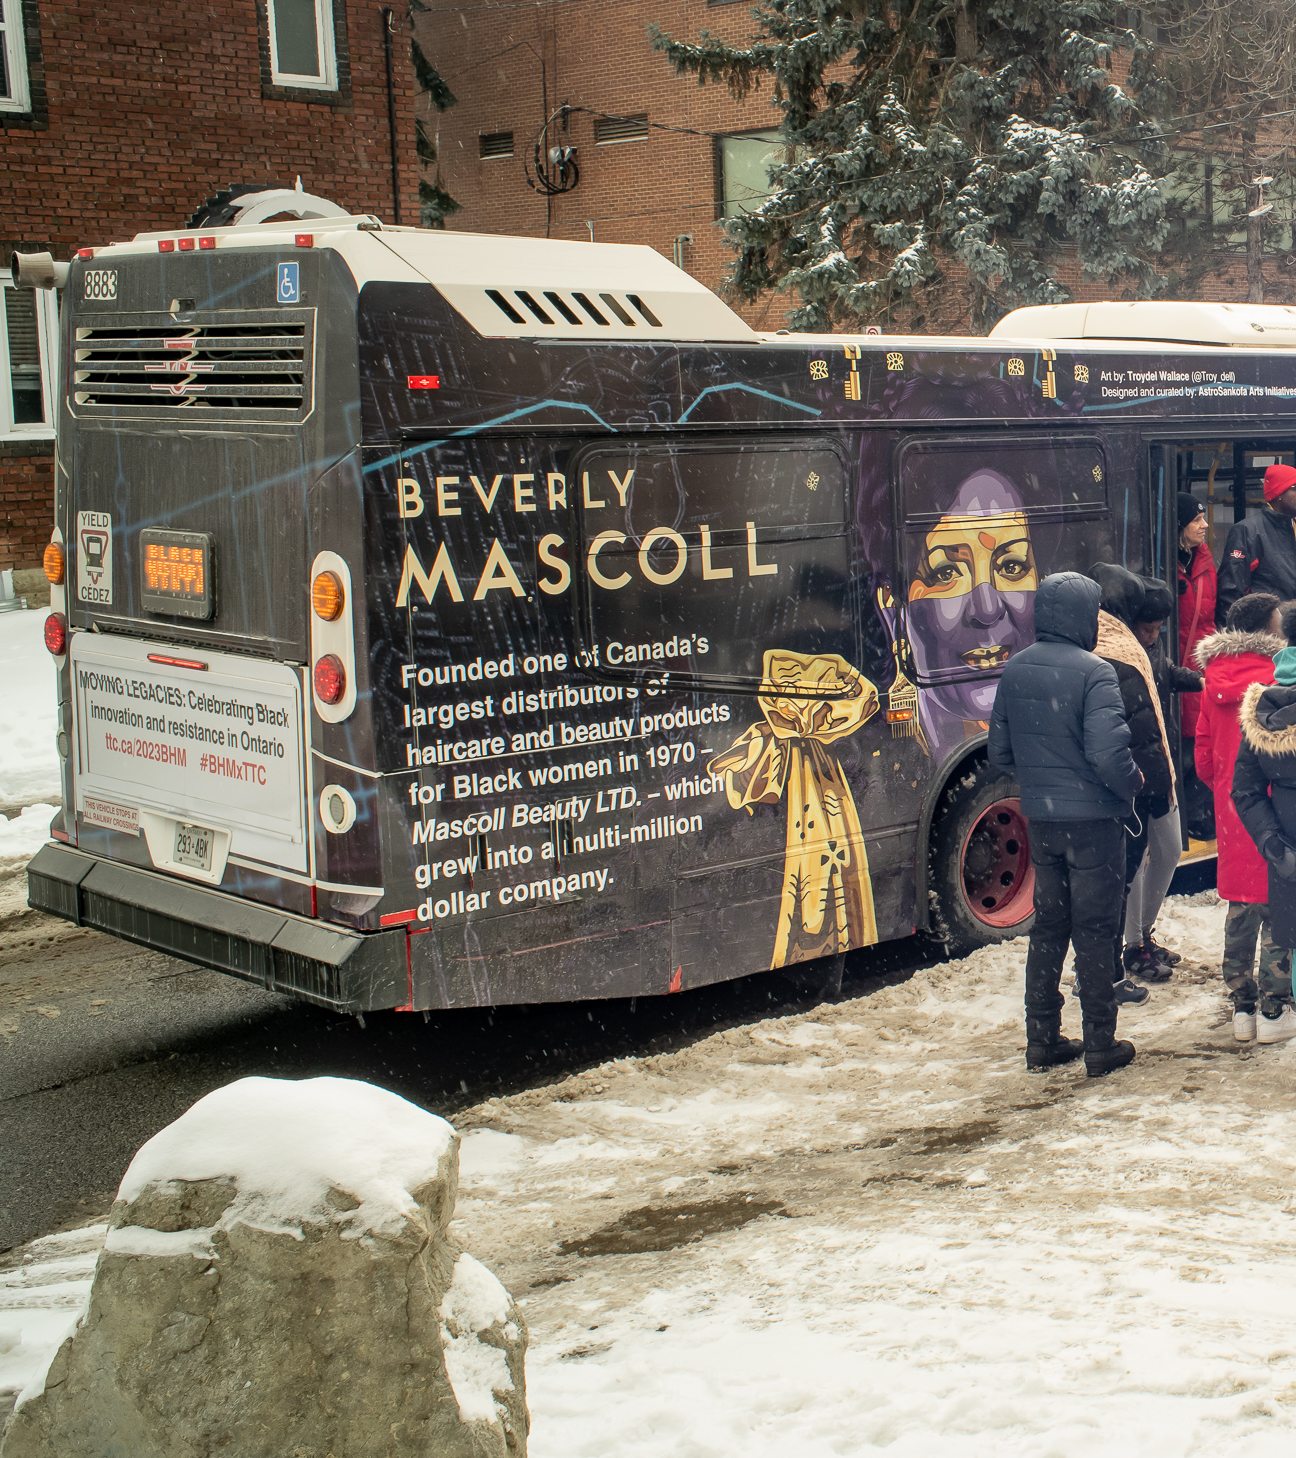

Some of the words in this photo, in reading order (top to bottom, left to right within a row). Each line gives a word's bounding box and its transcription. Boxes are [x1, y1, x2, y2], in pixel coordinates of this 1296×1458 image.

[85, 271, 117, 298] 8883
[1100, 371, 1113, 382] Art
[1113, 371, 1126, 383] by:
[1127, 371, 1158, 383] Troydel
[1158, 371, 1190, 382] Wallace
[1191, 371, 1236, 384] (@Troy_dell)
[1101, 386, 1139, 399] Designed
[1140, 387, 1154, 397] and
[1156, 387, 1184, 397] curated
[1185, 386, 1197, 398] by:
[1198, 386, 1248, 396] AstroSankofa
[1248, 386, 1264, 396] Arts
[396, 470, 636, 518] BEVERLY
[80, 512, 109, 528] YIELD
[149, 544, 203, 564] BLACK
[395, 521, 779, 608] MASCOLL
[81, 584, 110, 603] CÉDEZ
[401, 653, 515, 689] Founded
[523, 652, 568, 675] one
[79, 670, 125, 696] MOVING
[126, 678, 187, 708] LEGACIES:
[188, 690, 254, 726] Celebrating
[255, 702, 290, 729] Black
[403, 695, 495, 730] largest
[502, 683, 640, 715] distributors
[646, 672, 670, 697] of
[90, 700, 144, 729] innovation
[146, 714, 166, 734] and
[168, 718, 225, 746] resistance
[226, 728, 238, 749] in
[240, 730, 285, 759] Ontario
[406, 736, 506, 767] haircare
[511, 724, 555, 752] and
[560, 718, 635, 743] beauty
[640, 702, 731, 738] products
[105, 732, 187, 768] ttc.ca/2023BHM
[200, 752, 267, 786] #BHMxTTC
[408, 780, 446, 806] for
[453, 767, 523, 799] Black
[528, 758, 612, 787] women
[618, 750, 640, 774] in
[646, 741, 696, 769] 1970
[84, 811, 92, 820] ALL
[92, 812, 113, 825] RAILWAY
[112, 818, 140, 832] CROSSINGS
[85, 800, 96, 810] THIS
[96, 802, 116, 815] VEHICLE
[116, 808, 131, 819] STOPS
[132, 812, 138, 820] AT
[412, 807, 505, 845] Mascoll
[511, 796, 592, 829] Beauty
[595, 787, 642, 814] LTD.
[664, 772, 725, 802] which
[414, 855, 479, 890] grew
[485, 843, 534, 870] into
[540, 841, 555, 861] a
[416, 889, 492, 922] dollar
[499, 866, 615, 905] company.
